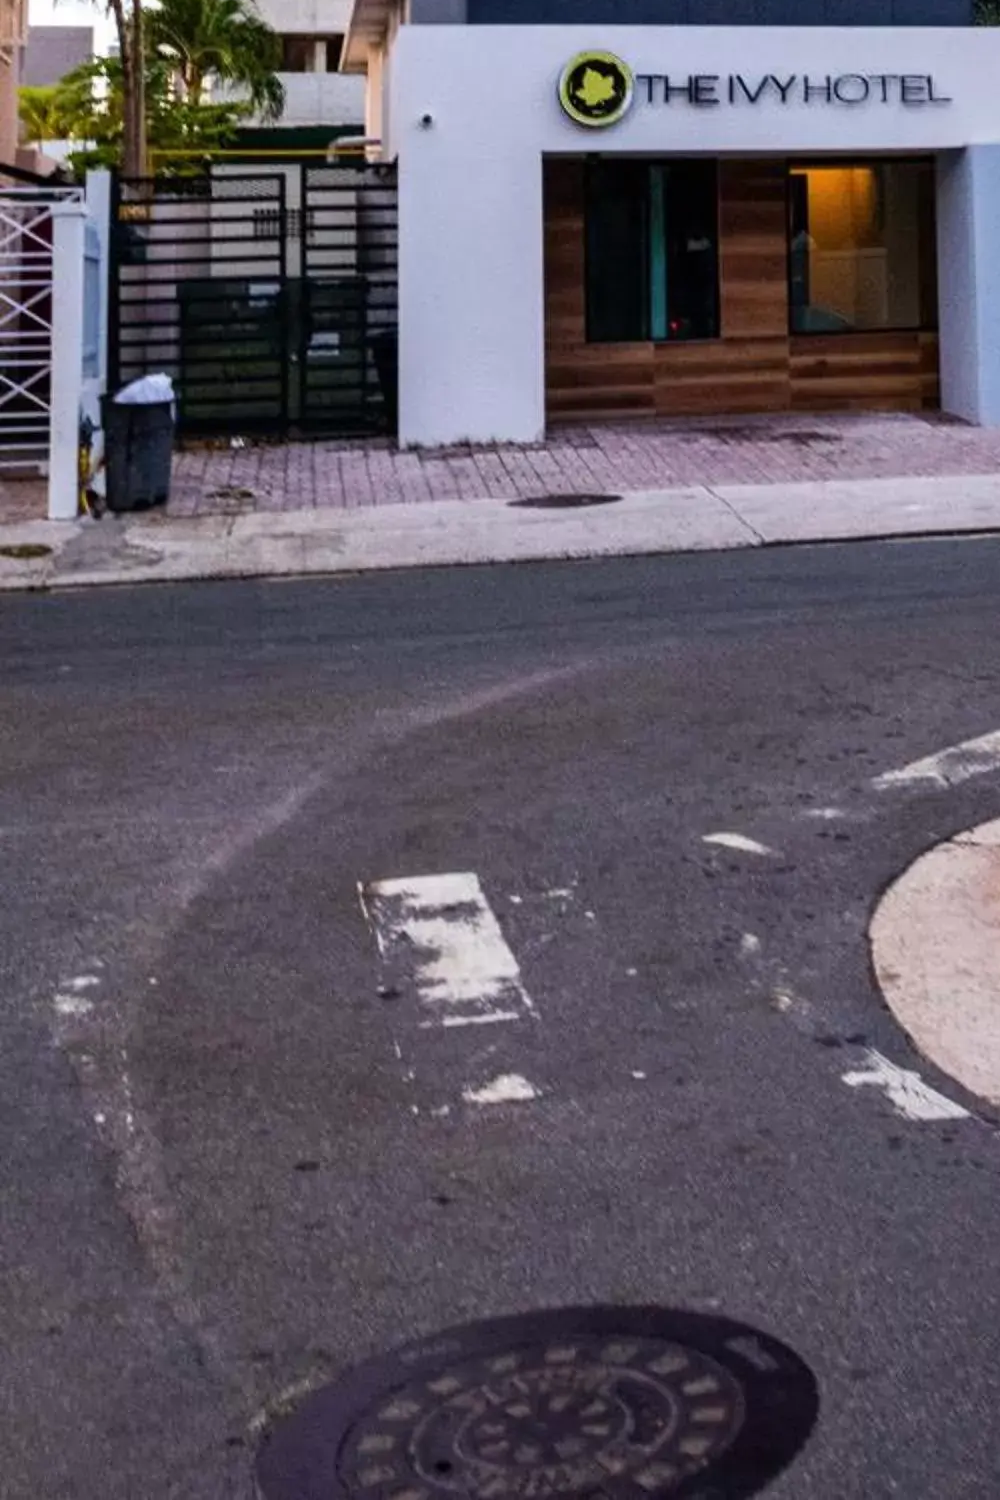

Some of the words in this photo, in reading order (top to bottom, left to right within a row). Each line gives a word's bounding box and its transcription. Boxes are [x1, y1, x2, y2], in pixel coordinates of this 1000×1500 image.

[635, 74, 721, 104] THE
[728, 74, 797, 104] IVY
[803, 73, 953, 104] HOTEL
